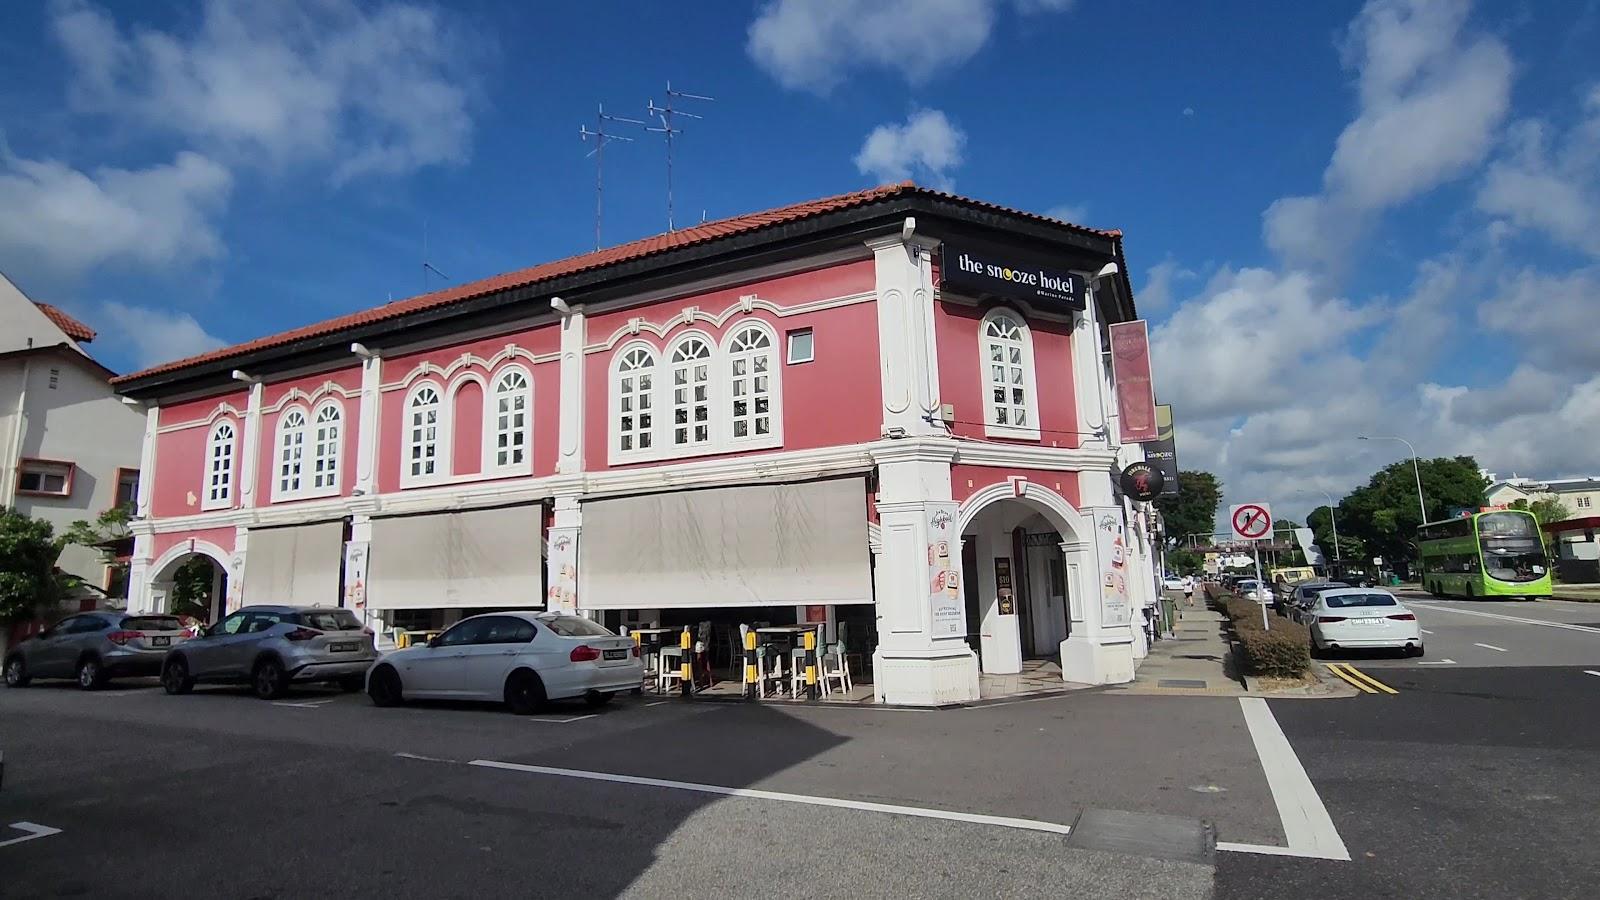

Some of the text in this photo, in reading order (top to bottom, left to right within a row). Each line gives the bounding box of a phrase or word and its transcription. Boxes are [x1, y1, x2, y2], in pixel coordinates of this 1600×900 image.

[958, 254, 1074, 294] the snooze hotel
